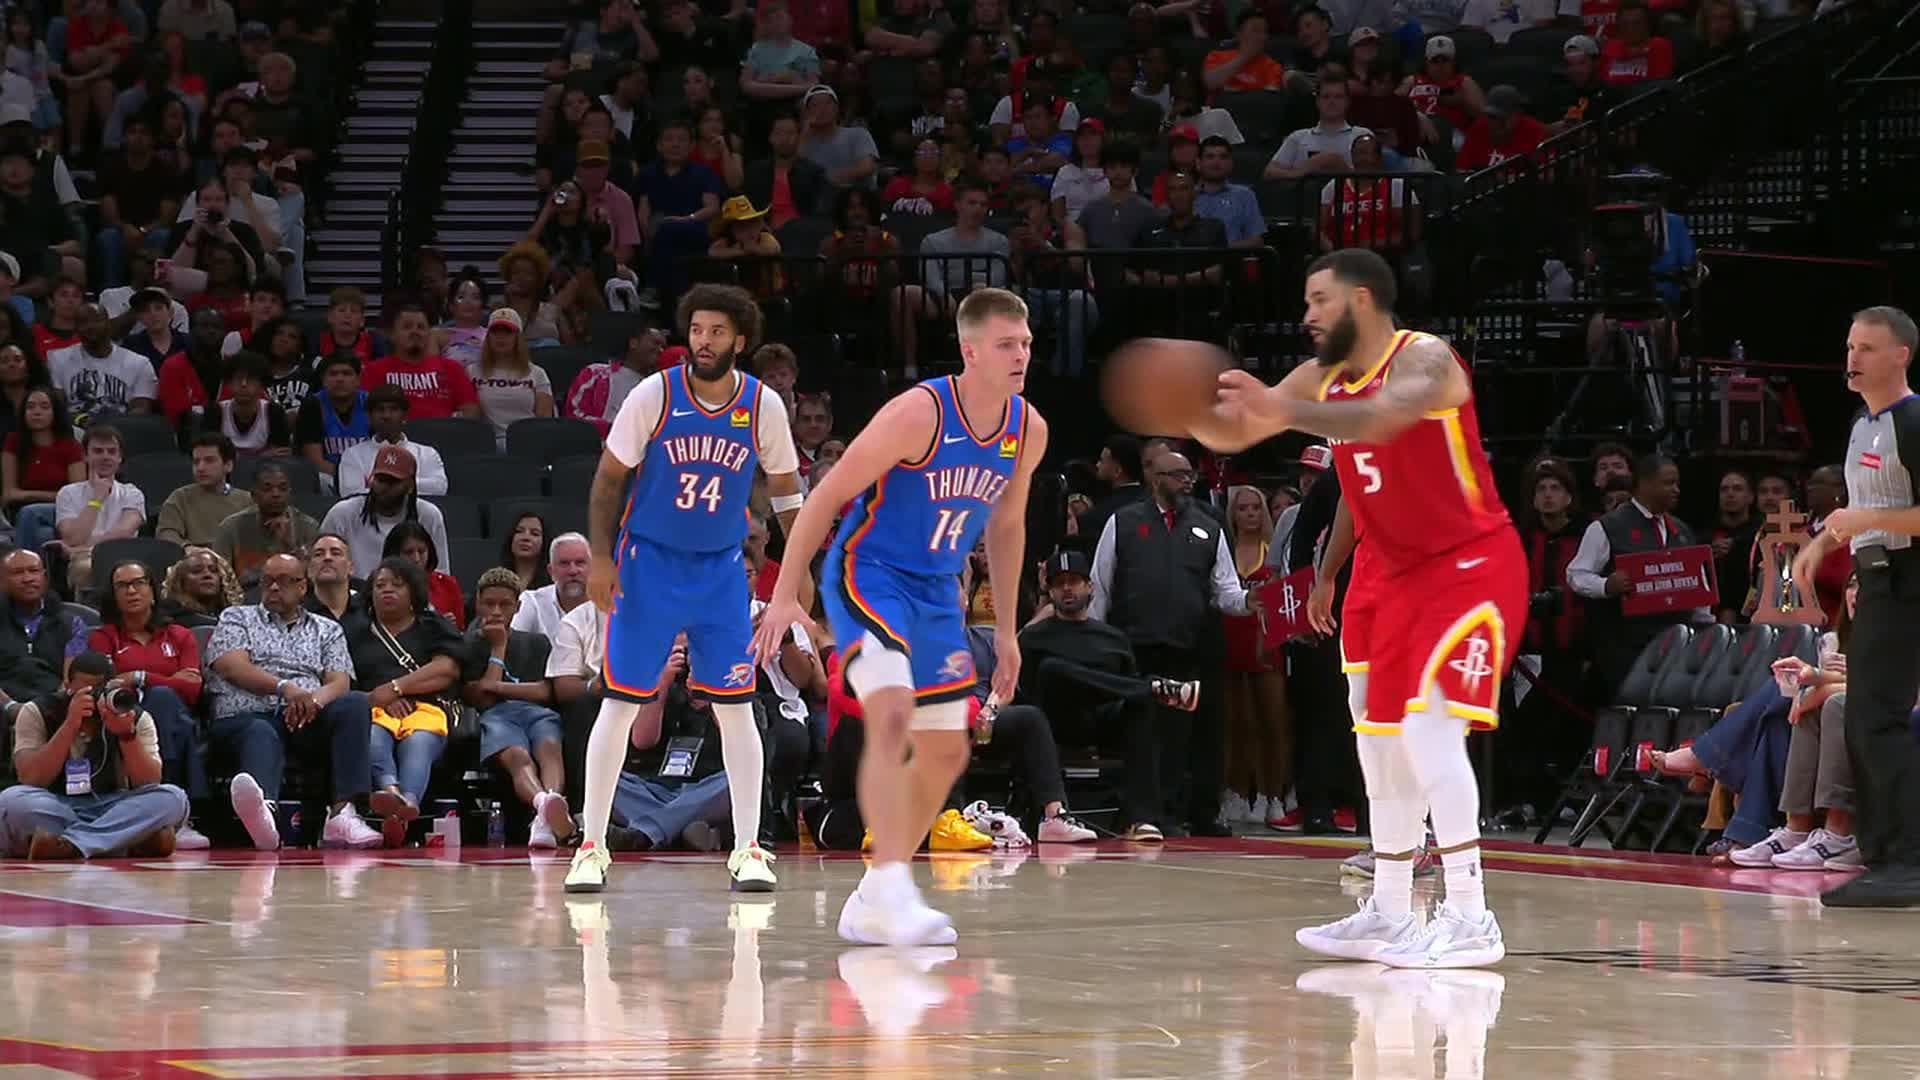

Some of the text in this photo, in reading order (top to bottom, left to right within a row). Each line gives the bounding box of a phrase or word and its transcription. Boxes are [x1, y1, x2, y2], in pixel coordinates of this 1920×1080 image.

[386, 371, 439, 391] DURANT
[663, 436, 750, 472] THUNDER
[1353, 451, 1383, 494] 5
[676, 472, 721, 512] 34
[929, 508, 971, 552] 14
